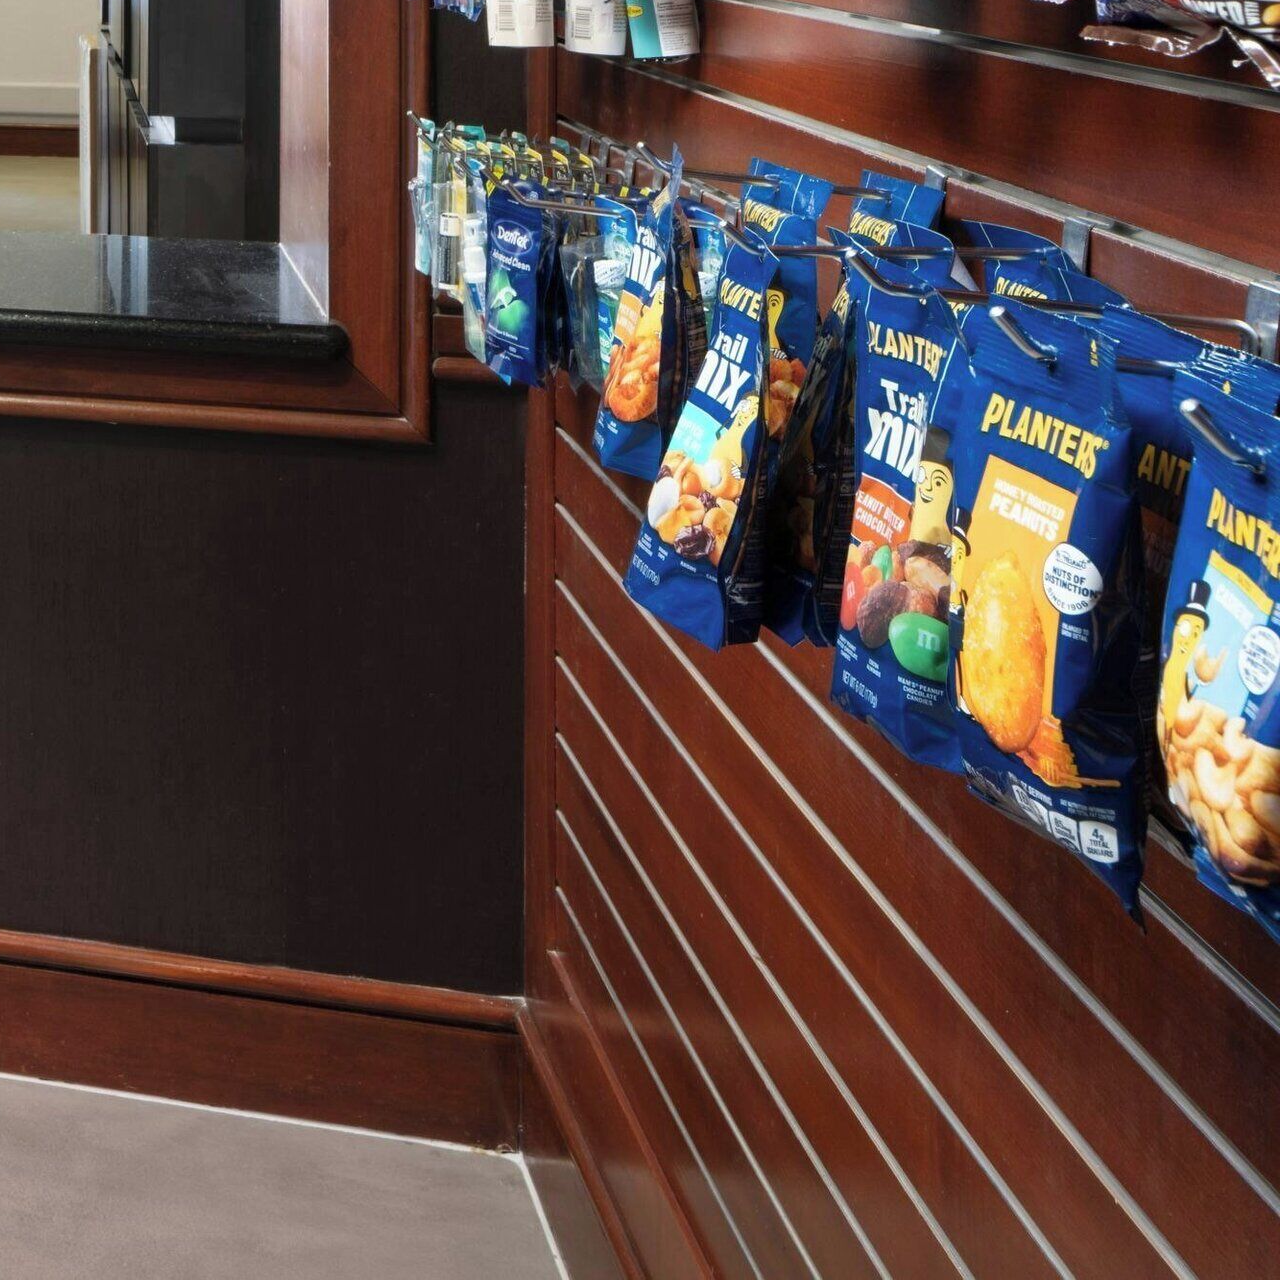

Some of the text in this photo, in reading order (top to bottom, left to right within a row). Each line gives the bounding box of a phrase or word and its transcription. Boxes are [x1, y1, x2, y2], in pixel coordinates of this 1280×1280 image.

[496, 223, 531, 251] DenTek
[513, 257, 532, 272] Clean
[981, 392, 1103, 480] PLANTERS
[994, 477, 1066, 522] HONEY ROASTED
[989, 494, 1059, 543] PEANUTS
[1044, 571, 1098, 599] DISTINCTION
[1052, 566, 1086, 586] NUTS OF
[1046, 586, 1089, 612] SINCE 1906
[903, 685, 938, 701] CHOCOLATE
[919, 683, 945, 697] PEANUT
[906, 693, 934, 706] CANDIES
[1089, 838, 1110, 849] TOTAL
[1091, 828, 1105, 842] 4g
[1086, 846, 1114, 858] SUGARS
